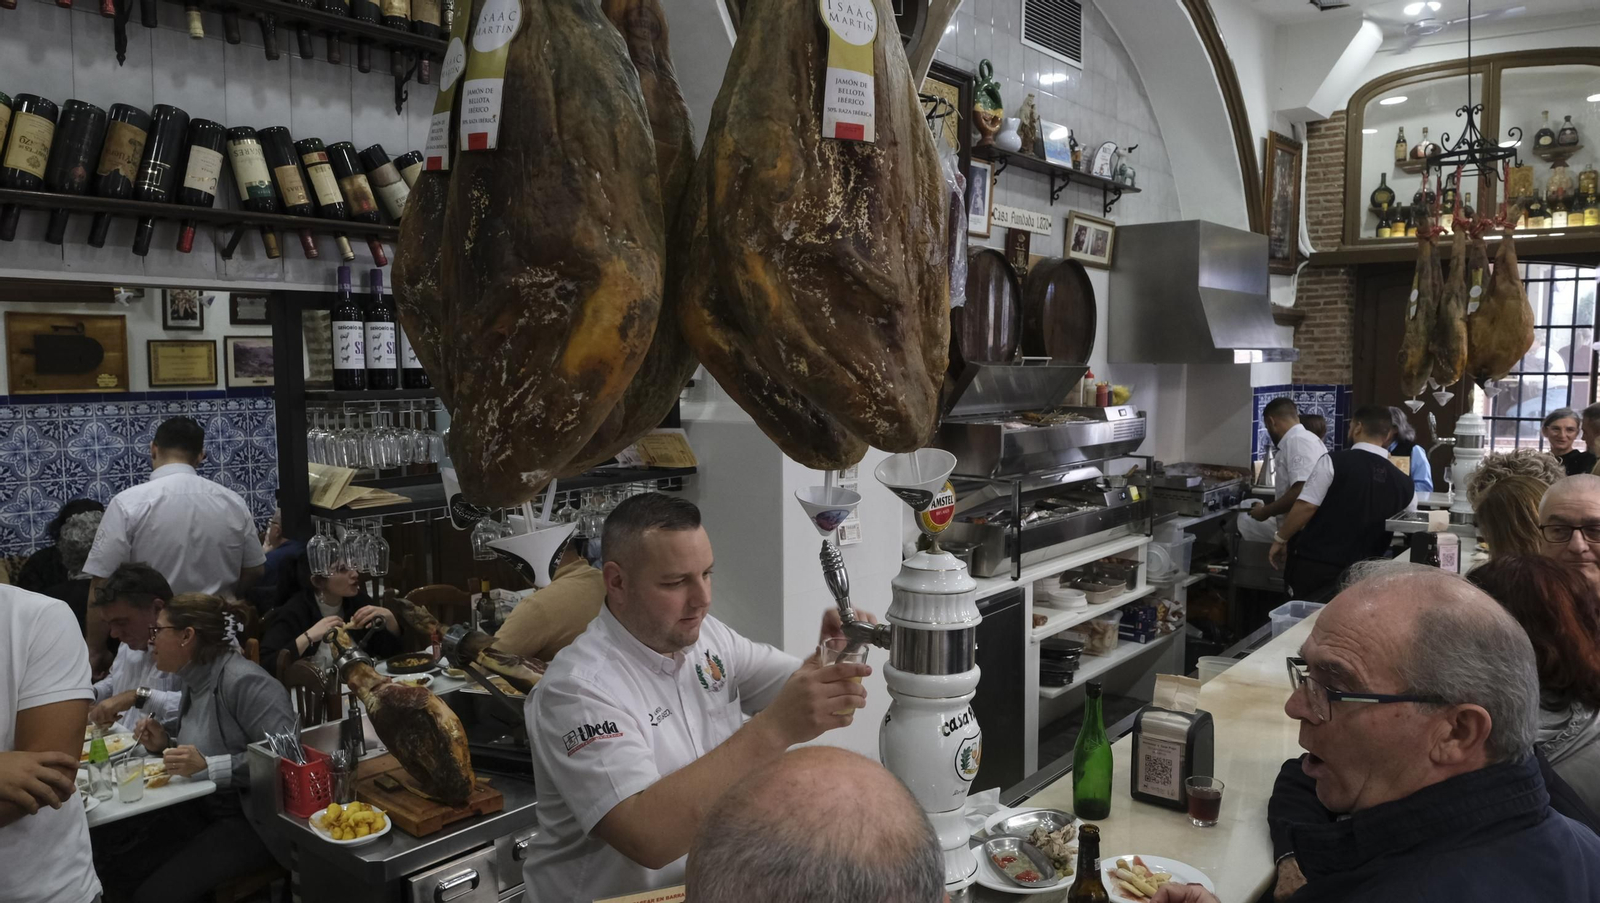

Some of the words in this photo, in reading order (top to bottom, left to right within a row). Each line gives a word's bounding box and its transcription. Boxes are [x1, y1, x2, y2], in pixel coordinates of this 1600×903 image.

[828, 0, 873, 21] ISAAC
[482, 11, 516, 24] SAAC
[835, 78, 858, 86] JAMÓN
[838, 88, 865, 97] BELLOTA
[993, 207, 1009, 222] Casa
[1010, 211, 1035, 228] Fundada
[931, 495, 954, 509] AMSTEL
[941, 712, 970, 737] casa
[665, 892, 686, 900] BARRA
